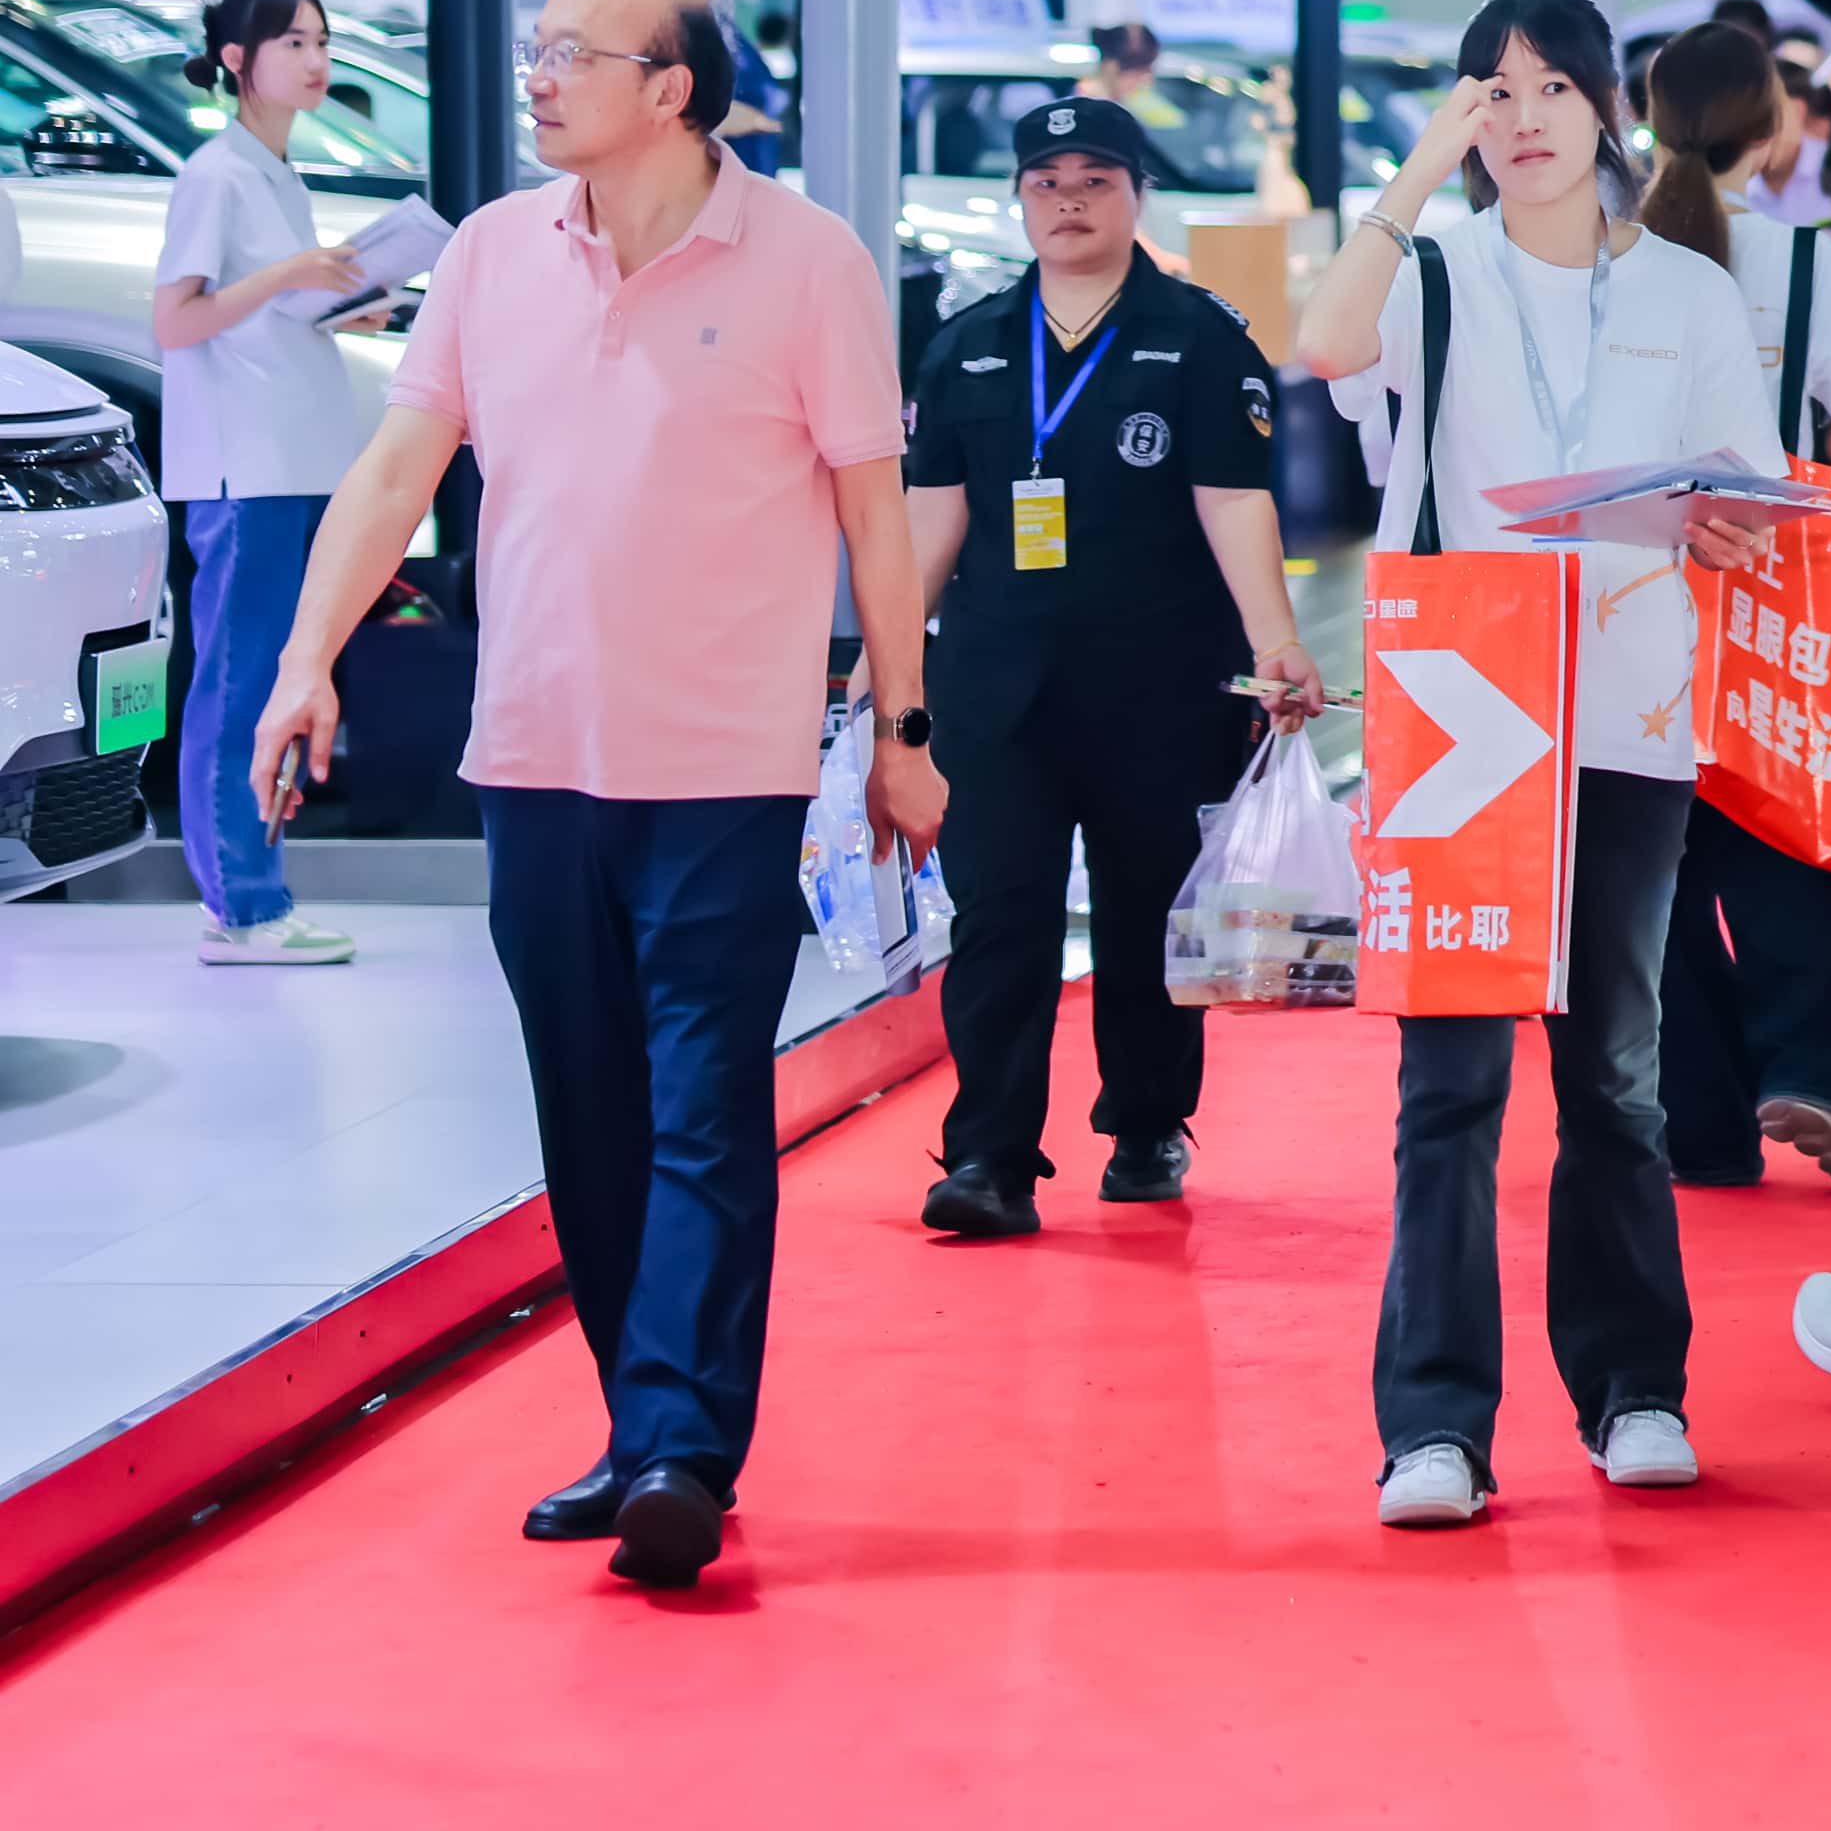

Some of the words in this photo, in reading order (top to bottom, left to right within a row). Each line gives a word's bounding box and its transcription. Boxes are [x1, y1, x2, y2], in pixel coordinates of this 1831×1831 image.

[1727, 586, 1831, 686] 显眼包
[1358, 867, 1511, 953] 活比耶
